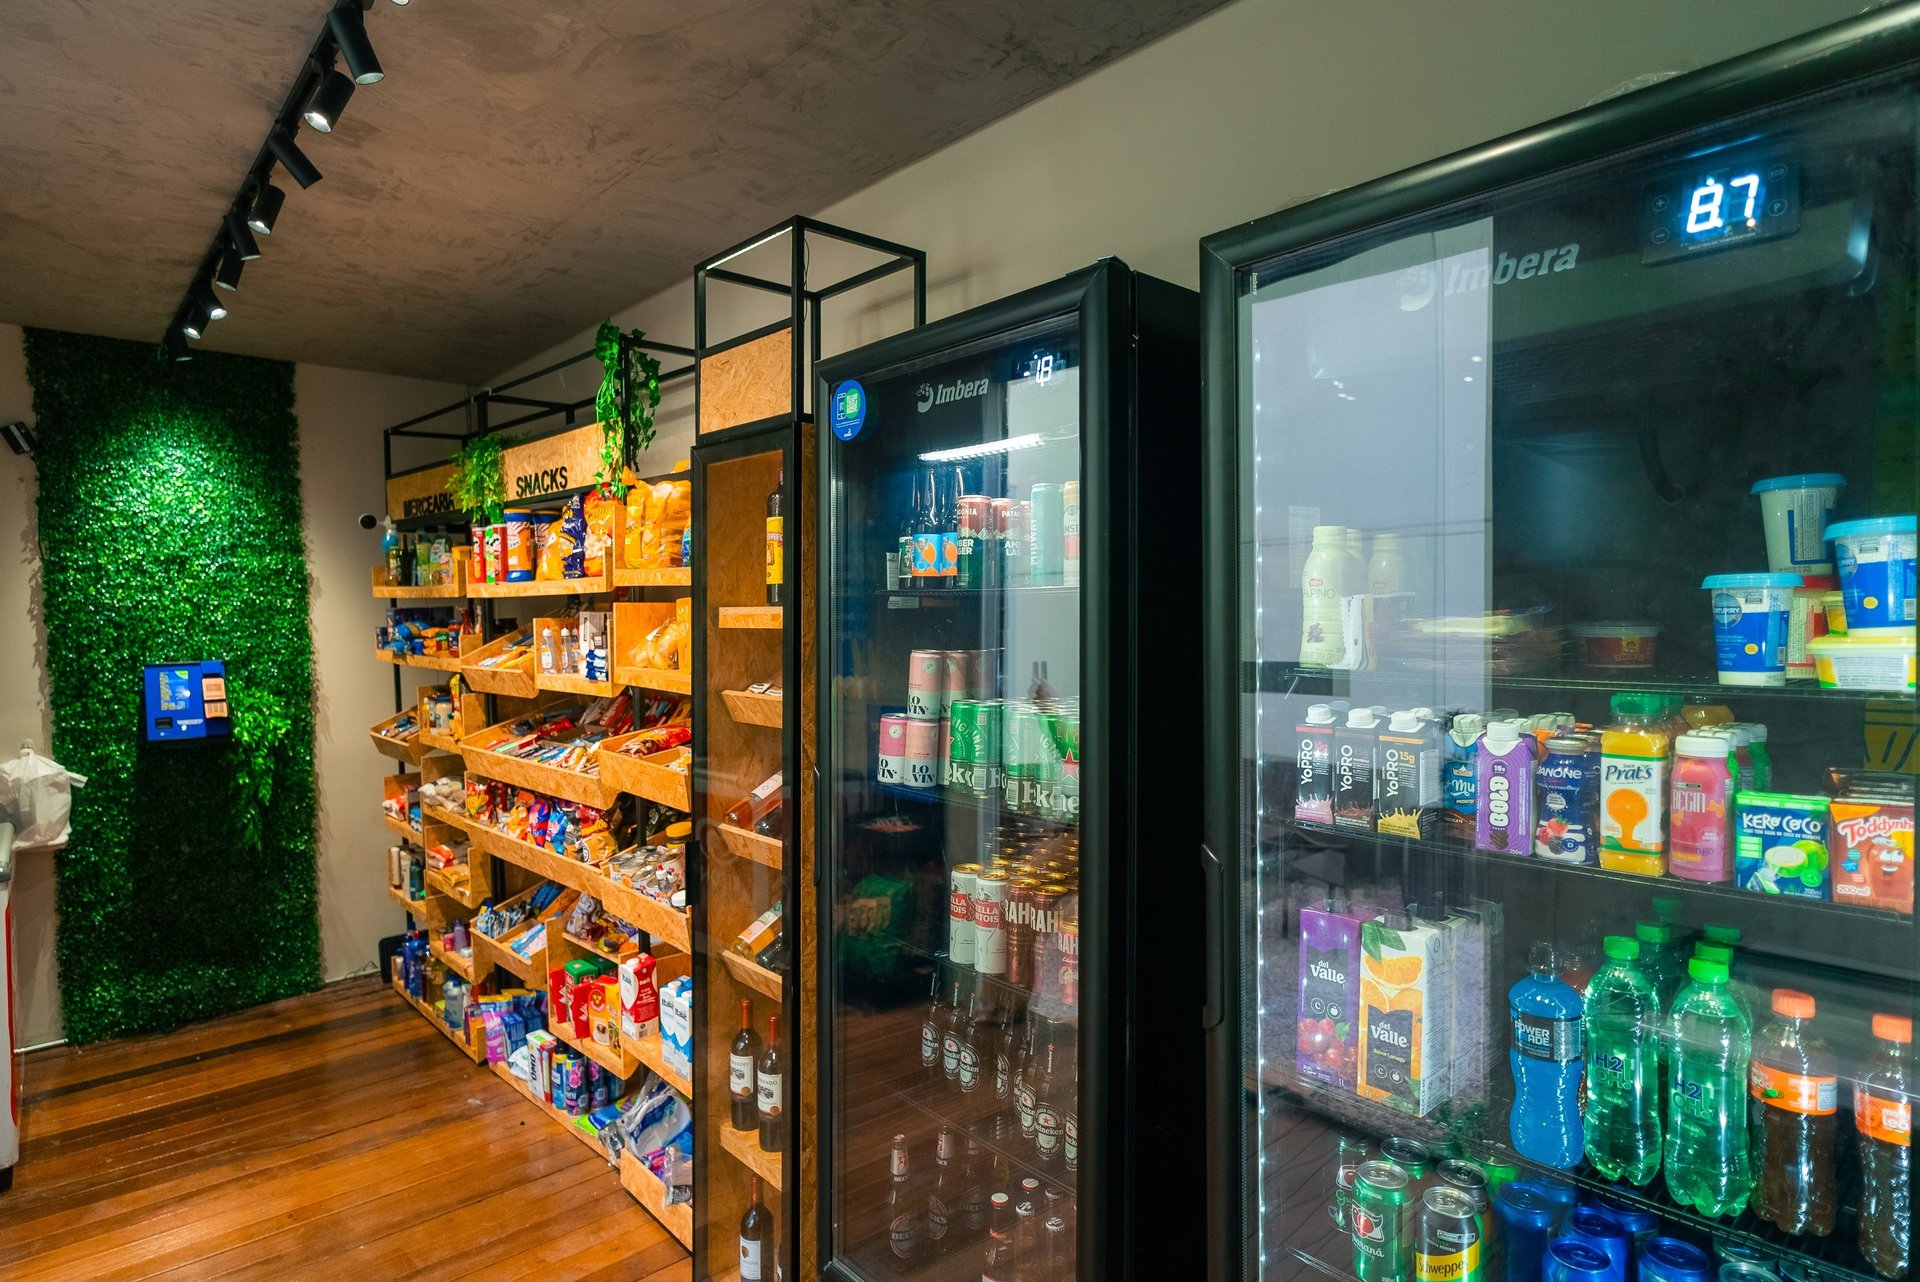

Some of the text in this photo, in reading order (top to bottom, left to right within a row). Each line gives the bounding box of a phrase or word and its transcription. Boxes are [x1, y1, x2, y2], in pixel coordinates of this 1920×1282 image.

[1443, 243, 1580, 296] Imbera
[936, 378, 989, 405] Imbera
[516, 466, 568, 499] SNACKS
[957, 547, 973, 555] GER
[958, 539, 974, 547] BER
[1300, 739, 1313, 785] YoPRO
[1340, 744, 1353, 792] YoPRO
[1386, 749, 1399, 798] YoPRO
[1605, 764, 1653, 782] Prats
[1488, 775, 1509, 827] BOLD
[950, 895, 966, 906] ELLA
[975, 905, 999, 916] TELLA
[1317, 960, 1329, 969] del
[1379, 1021, 1391, 1031] del
[1514, 1020, 1550, 1039] POWER
[1528, 1034, 1550, 1046] ADE
[1596, 1052, 1623, 1074] H2
[1673, 1077, 1701, 1102] H2
